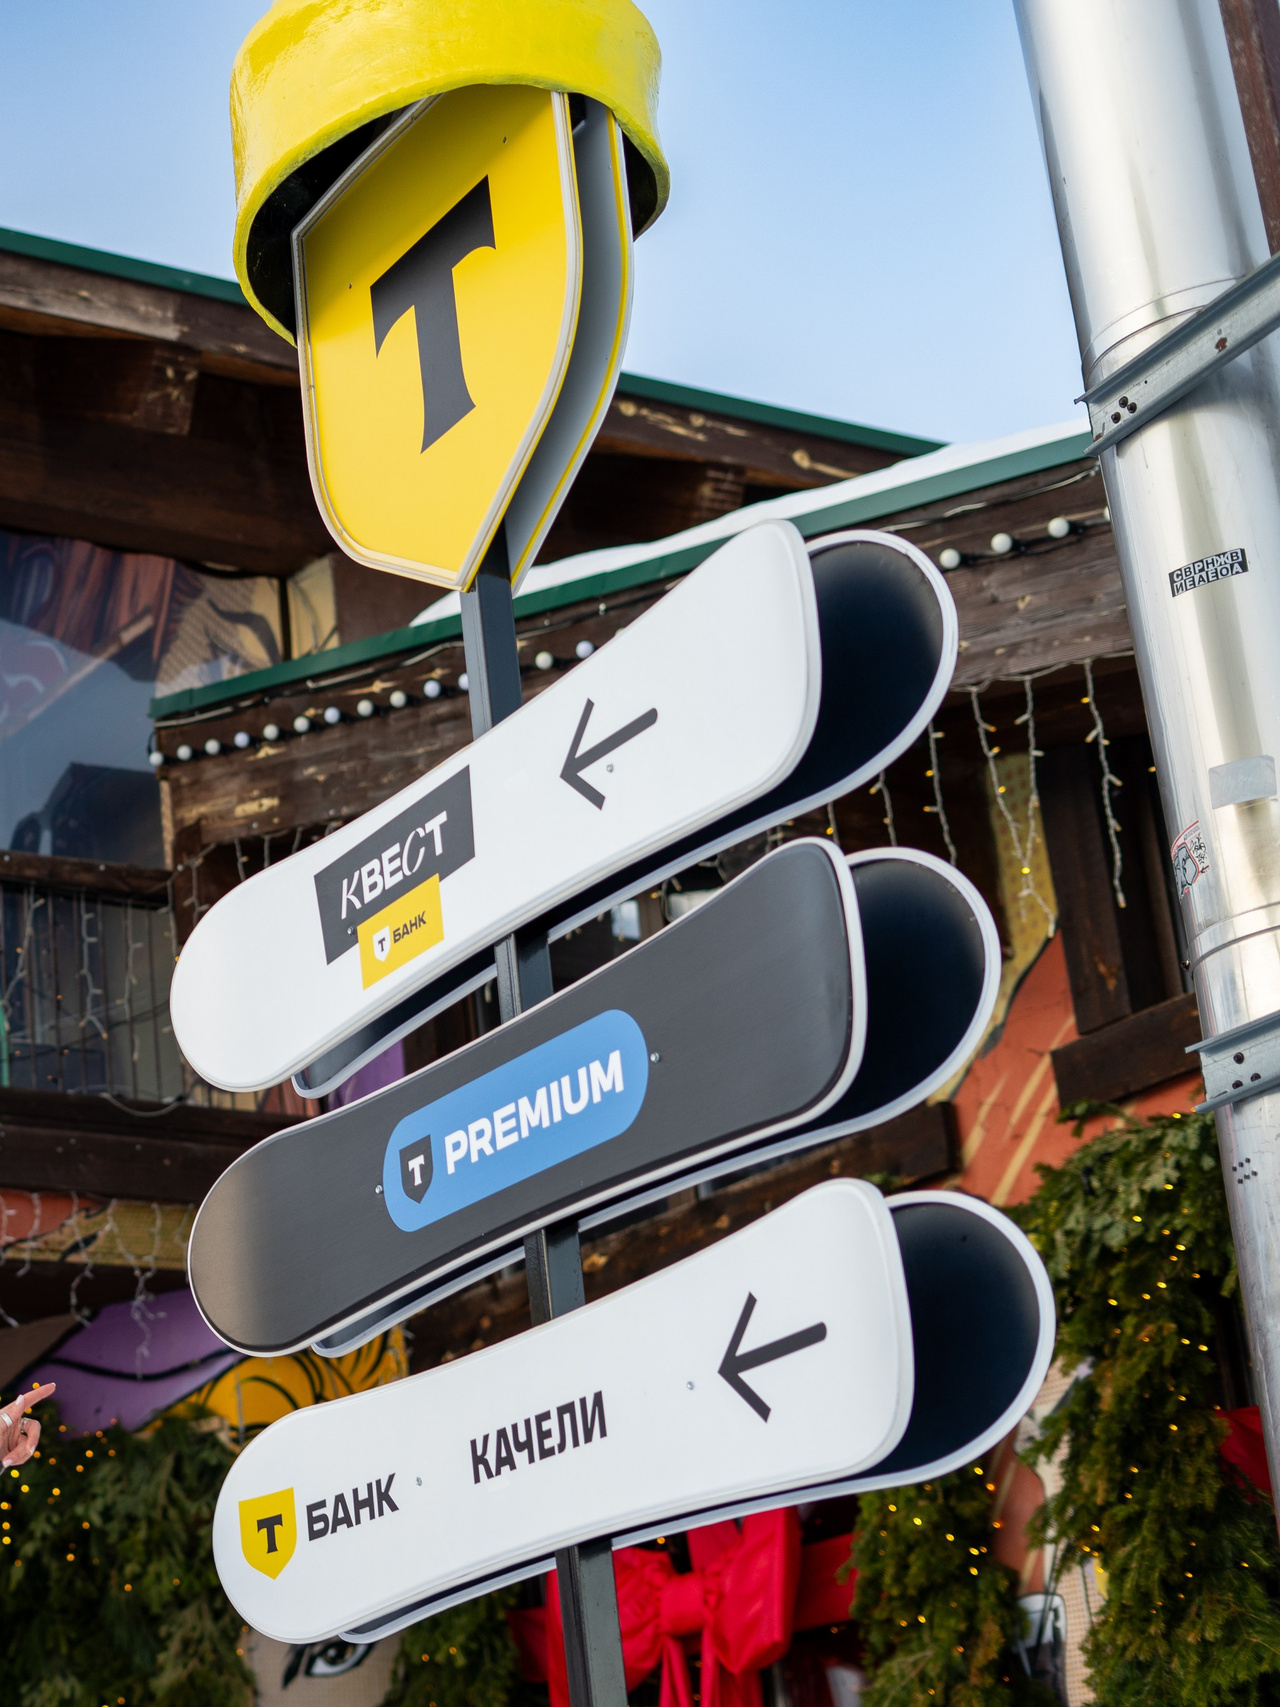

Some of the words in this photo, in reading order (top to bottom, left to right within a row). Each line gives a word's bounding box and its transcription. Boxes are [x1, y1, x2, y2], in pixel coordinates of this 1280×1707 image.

[341, 811, 447, 920] КВЕСТ
[393, 910, 427, 944] БАНК
[444, 1049, 624, 1175] PREMIUM
[470, 1390, 608, 1485] КАЧЕЛИ
[306, 1472, 400, 1542] БАНК
